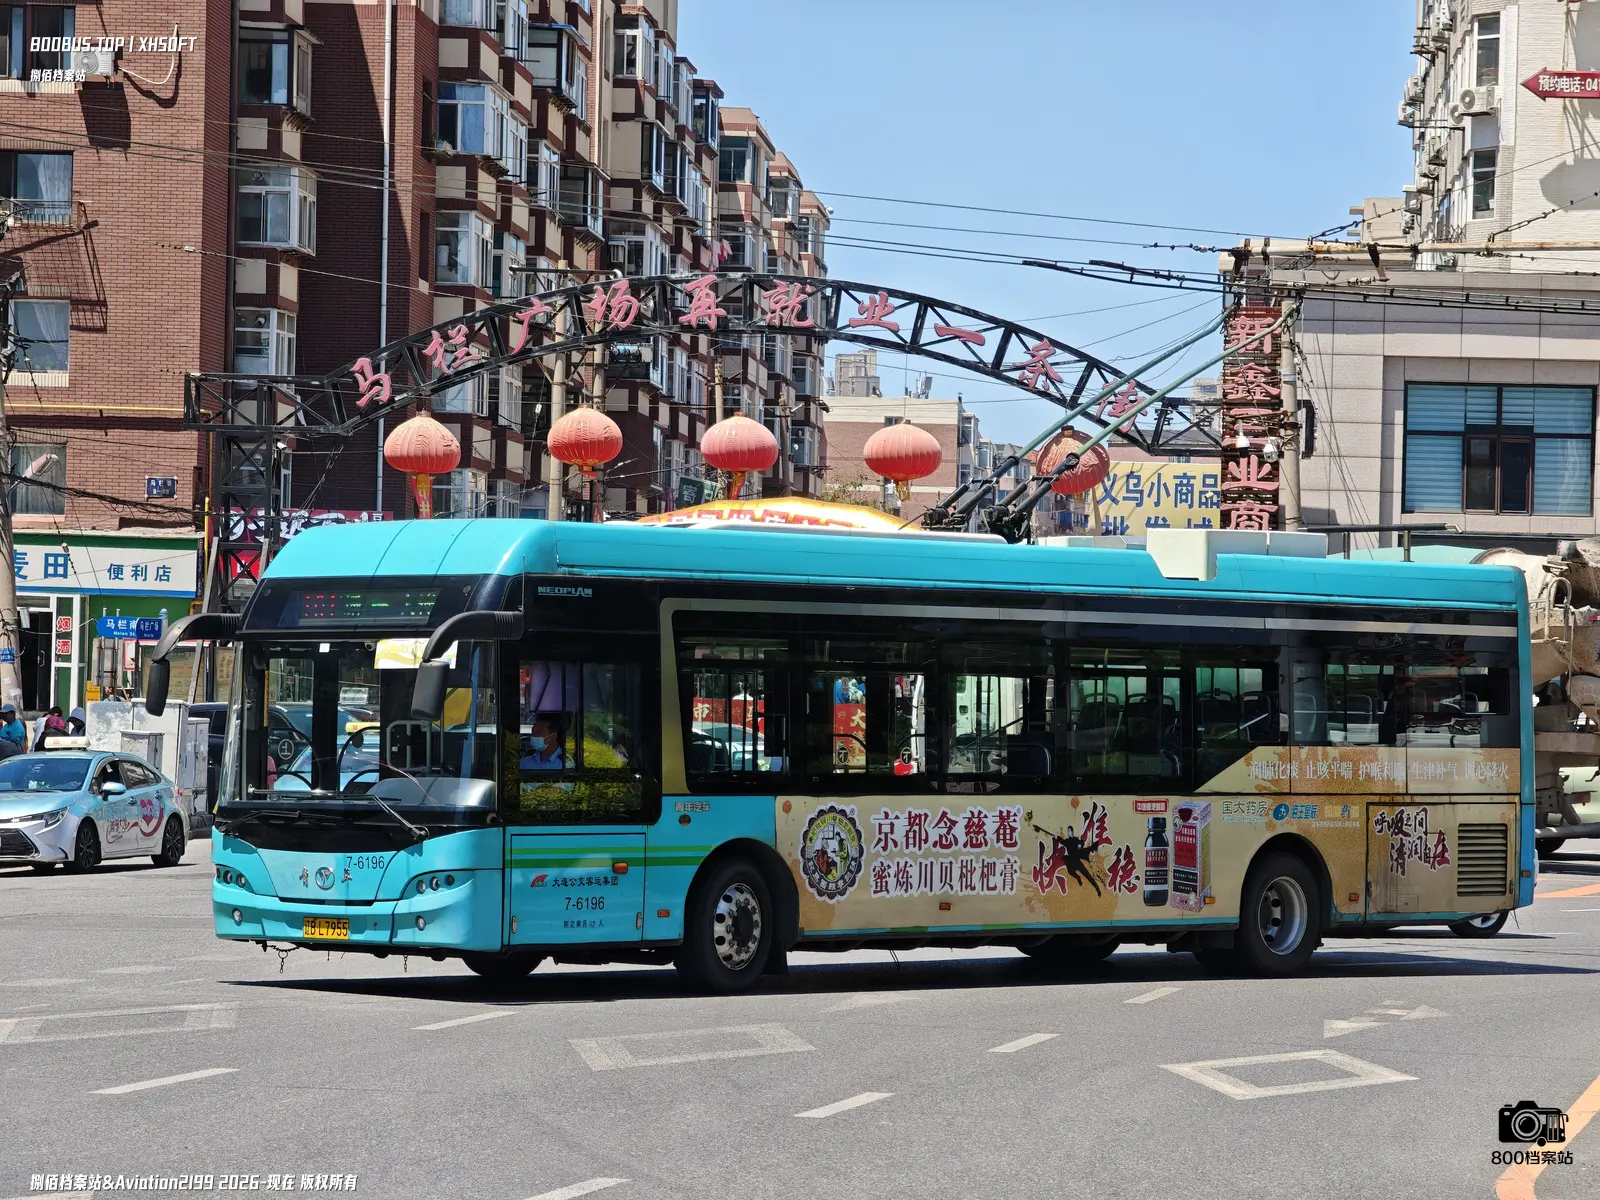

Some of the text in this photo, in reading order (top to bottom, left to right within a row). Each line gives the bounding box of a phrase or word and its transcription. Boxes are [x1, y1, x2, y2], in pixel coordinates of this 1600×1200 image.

[1538, 74, 1600, 93] 预约电话:04
[349, 273, 1148, 434] 马栏广场再就业一条街
[1096, 470, 1222, 510] 义乌小商品
[106, 562, 172, 582] 便利店
[537, 586, 593, 597] NEOPLAN
[1304, 760, 1353, 780] 止咳平喘
[1411, 761, 1459, 780] 生津补气
[1222, 800, 1268, 815] 国大药房
[1374, 807, 1429, 838] 呼吸之间
[346, 855, 386, 870] 7-6196
[552, 875, 619, 888] 大连公交客运集团
[871, 857, 1018, 896] 蜜炼川贝枇杷膏
[564, 895, 605, 911] 7-6196
